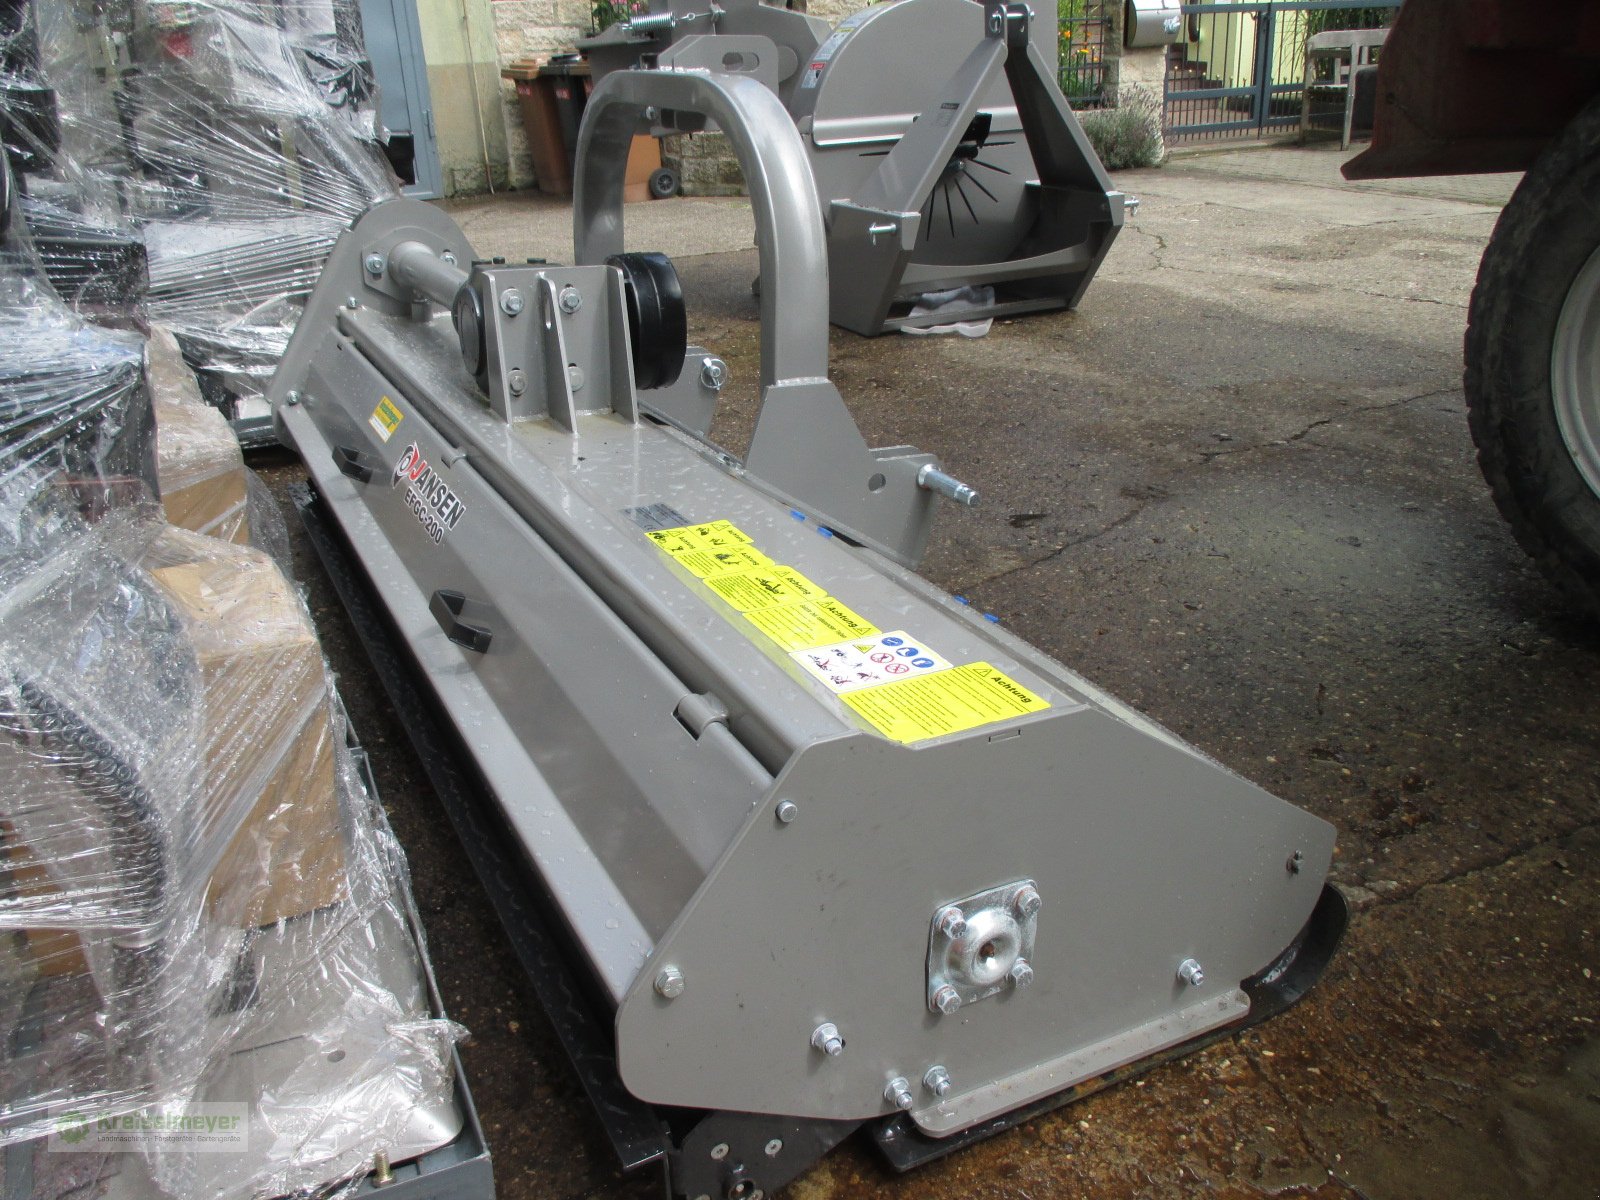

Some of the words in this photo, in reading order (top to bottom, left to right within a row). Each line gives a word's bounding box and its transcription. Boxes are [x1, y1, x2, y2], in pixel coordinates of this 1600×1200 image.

[409, 460, 466, 531] JANSEN
[404, 486, 444, 545] EFGC-200
[785, 577, 812, 595] Achtung
[826, 607, 858, 628] Achtung
[991, 676, 1032, 703] Achtung
